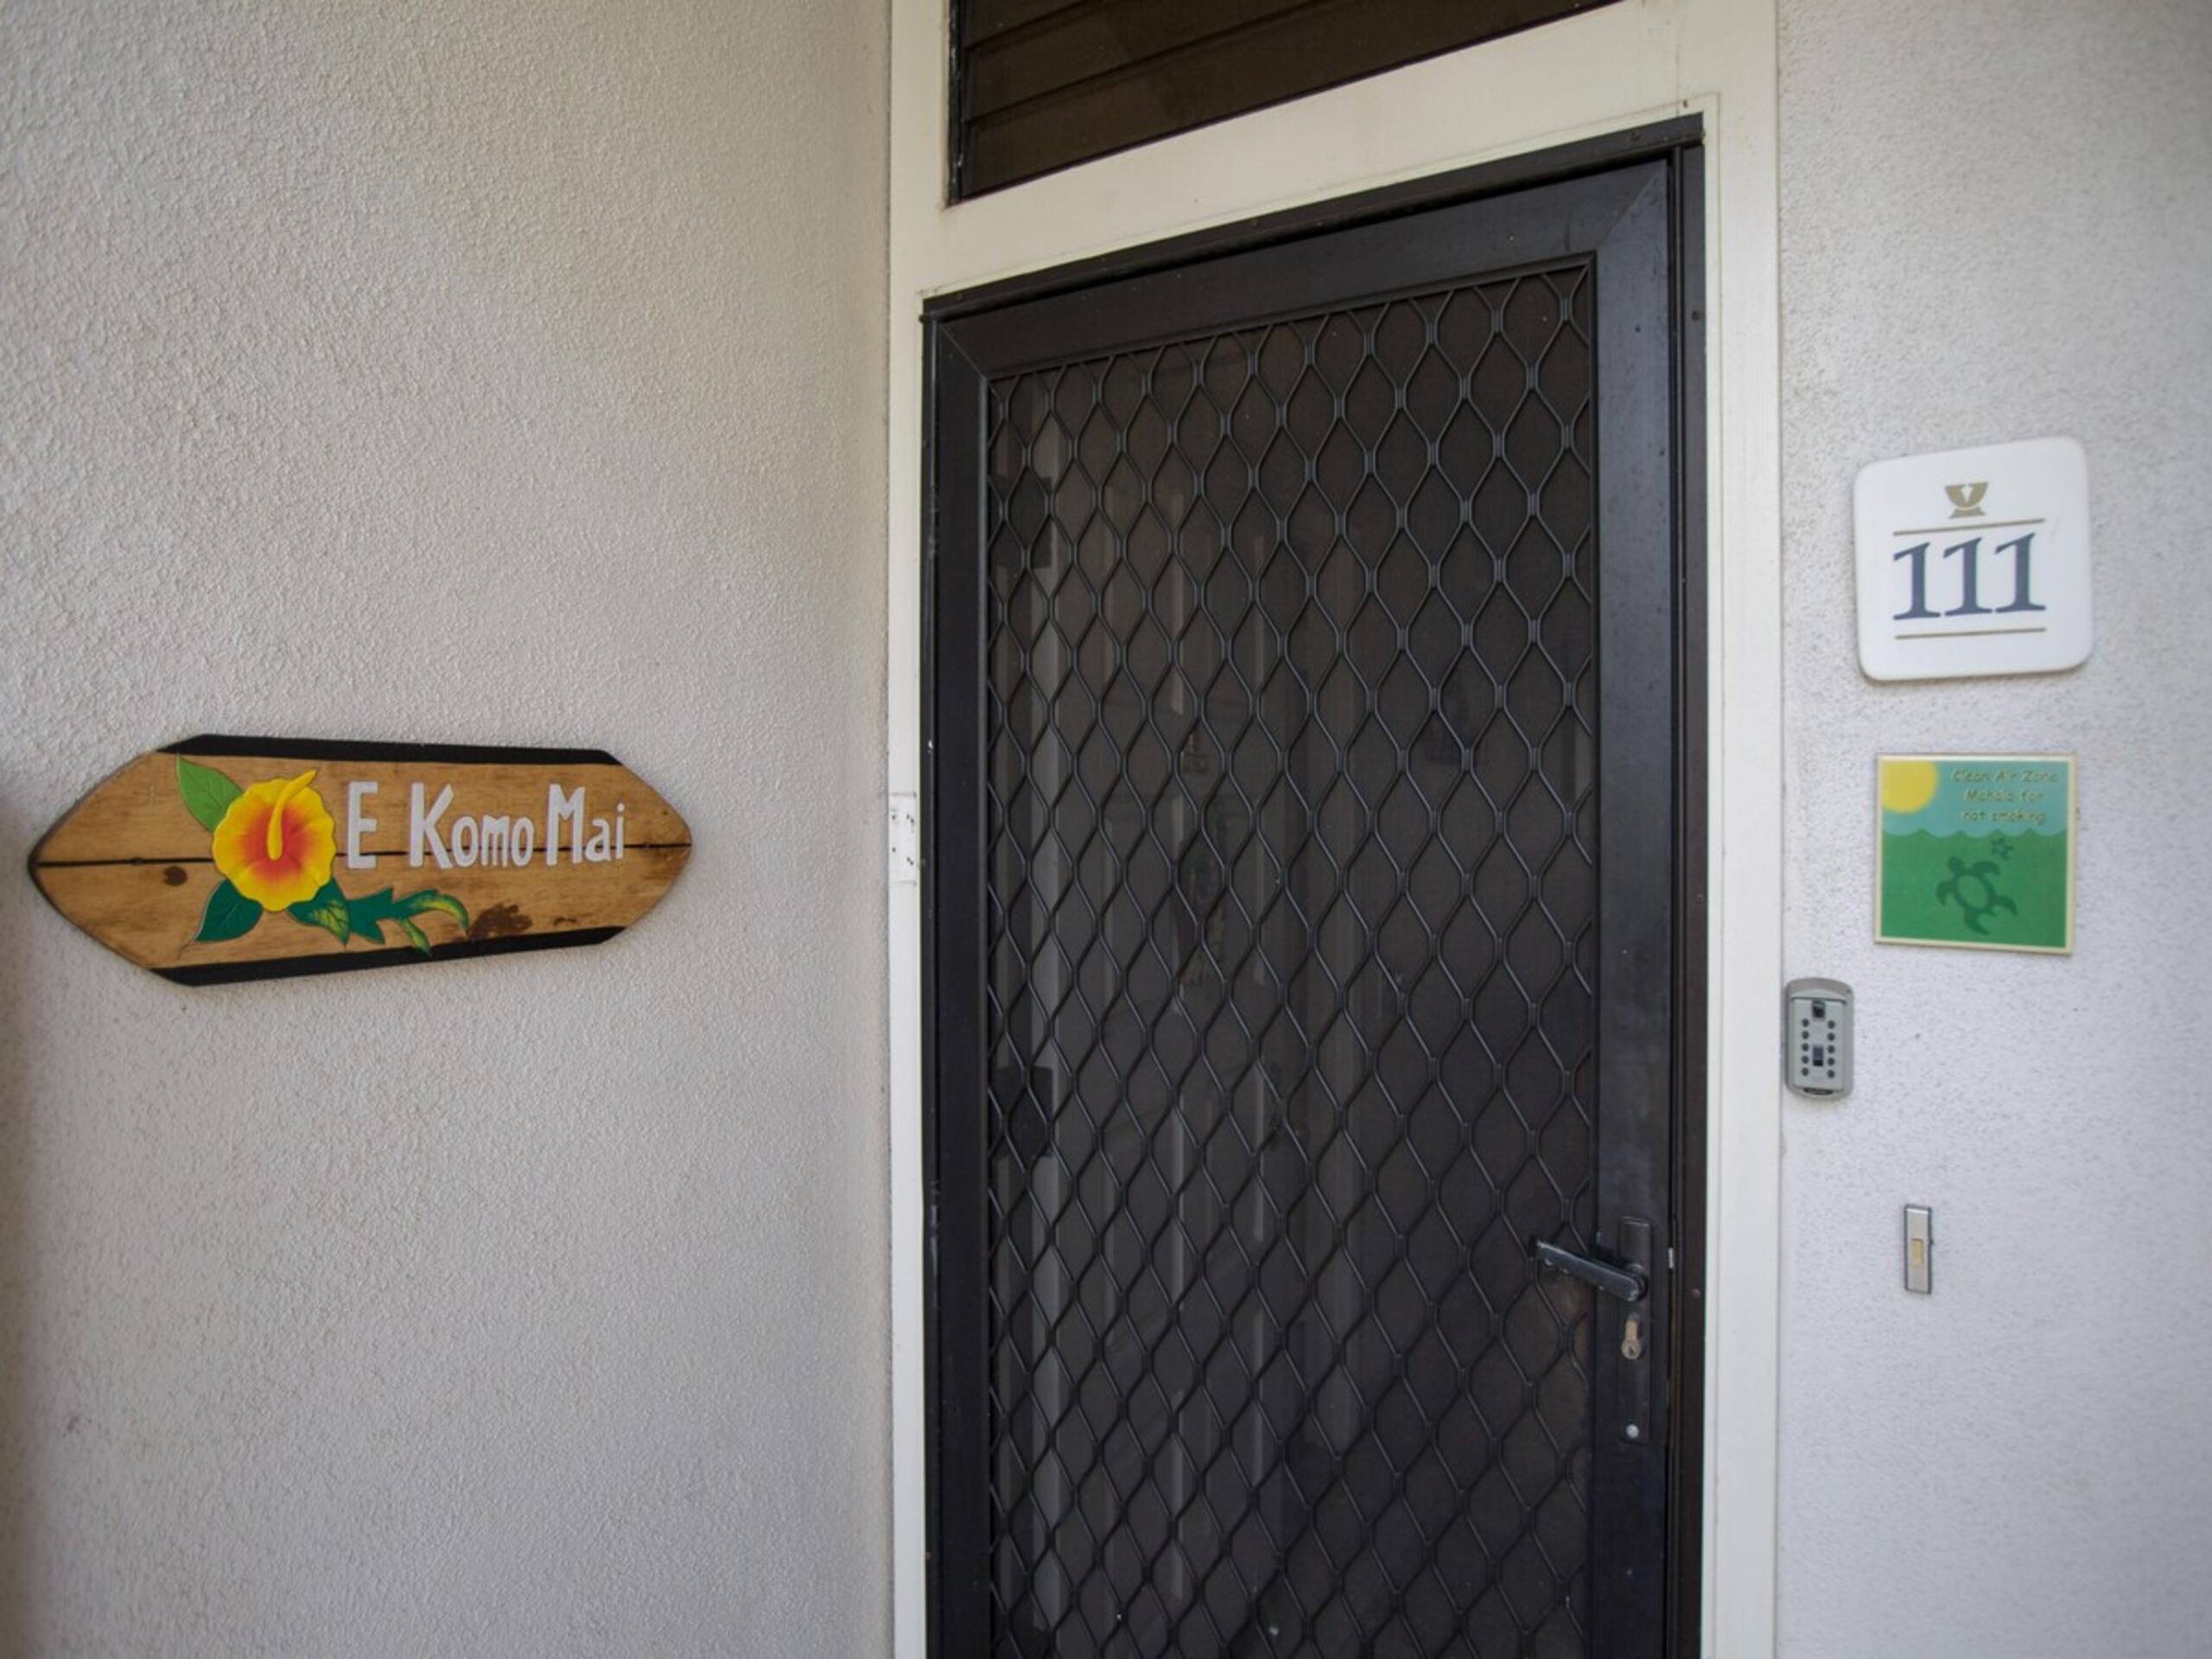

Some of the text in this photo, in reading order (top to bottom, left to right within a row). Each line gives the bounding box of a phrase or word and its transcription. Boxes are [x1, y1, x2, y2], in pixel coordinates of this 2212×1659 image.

[1893, 532, 2046, 620] 111
[1962, 810, 2046, 825] not smoking
[2021, 789, 2044, 802] for
[346, 781, 626, 869] E Komo Mai
